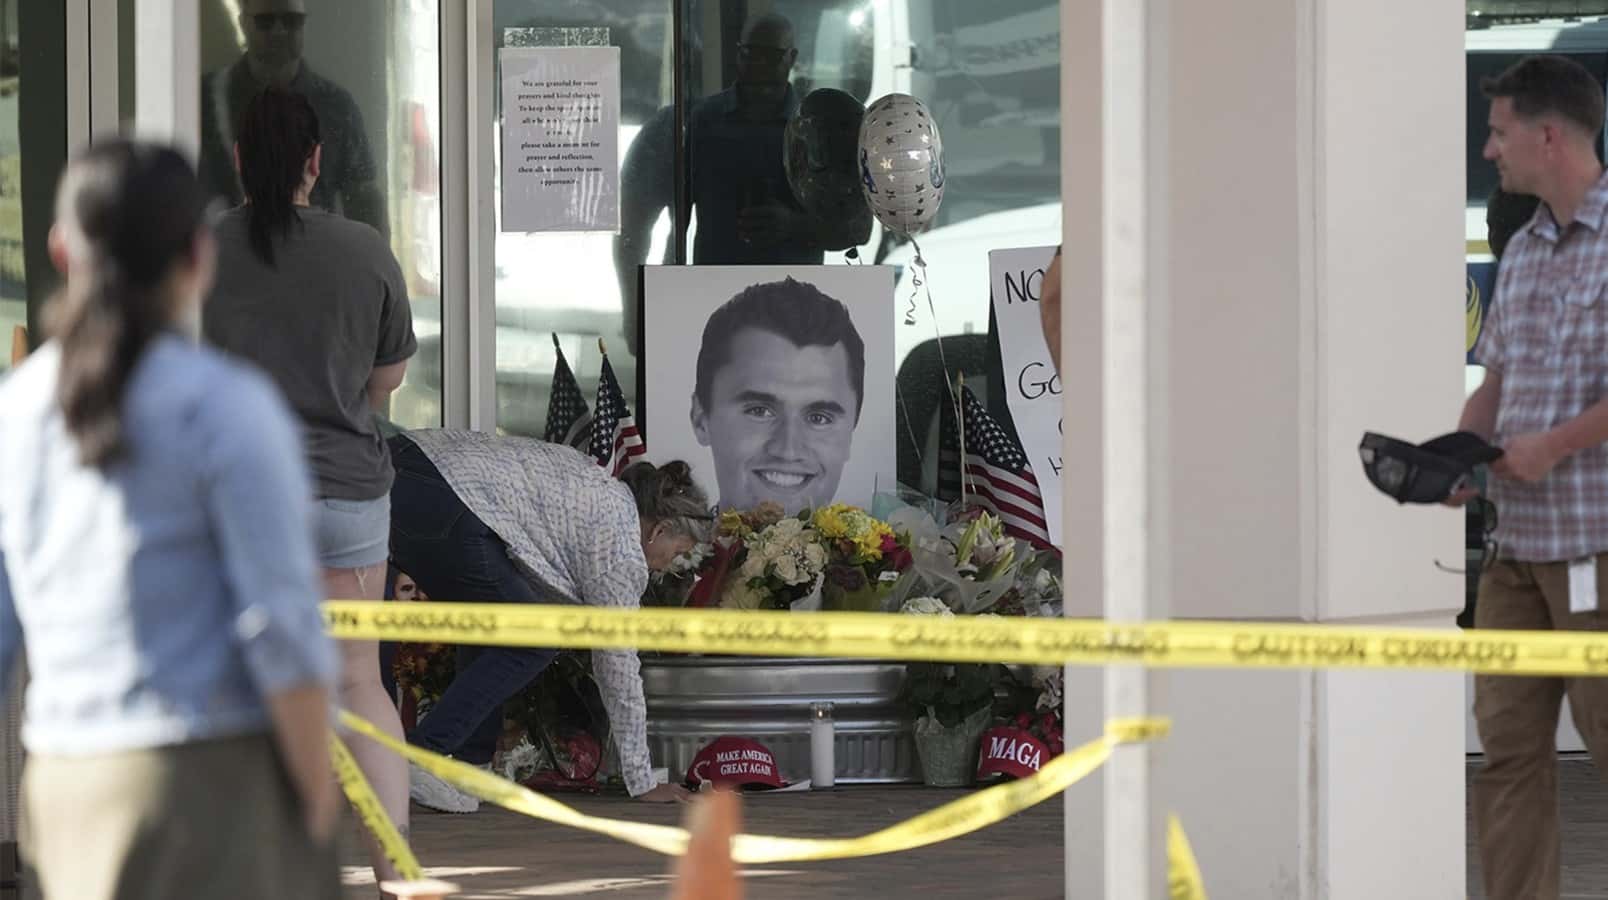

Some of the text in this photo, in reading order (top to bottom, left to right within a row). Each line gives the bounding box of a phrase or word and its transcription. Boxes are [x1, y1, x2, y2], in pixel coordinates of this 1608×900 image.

[546, 80, 571, 88] grateful
[521, 142, 541, 150] please
[526, 154, 547, 162] prayer
[535, 165, 551, 173] allw
[1232, 630, 1368, 663] CAUTION
[1380, 635, 1518, 668] CUIDADO
[716, 749, 774, 765] MAKE AMERICA
[988, 736, 1042, 771] MAGA
[720, 762, 772, 777] GREAT AGAIN
